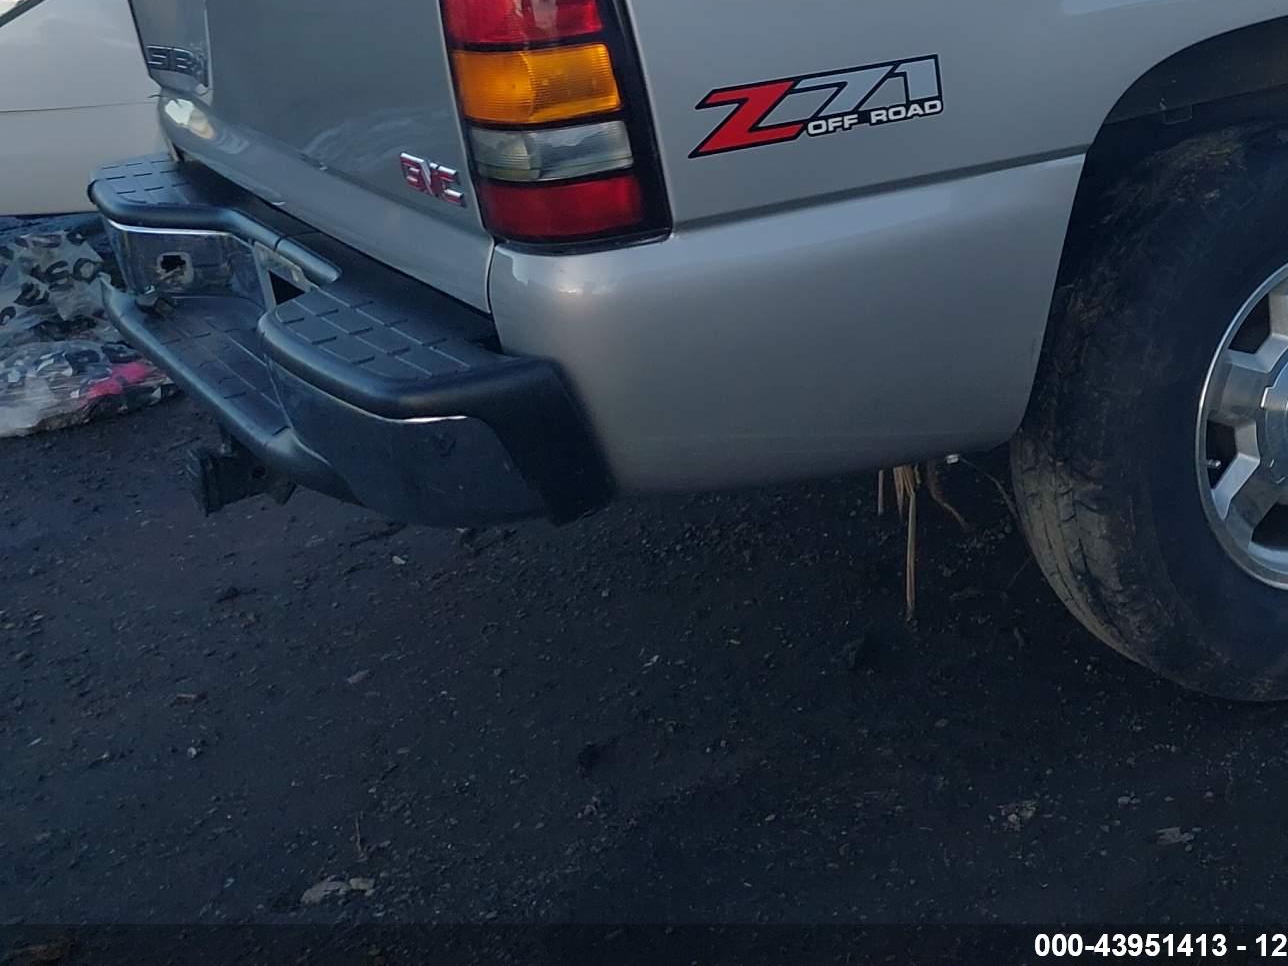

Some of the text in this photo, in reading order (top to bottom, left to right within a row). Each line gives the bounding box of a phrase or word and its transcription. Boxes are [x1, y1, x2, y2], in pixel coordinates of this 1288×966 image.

[688, 53, 943, 159] Z71
[807, 99, 943, 135] OFF ROAD
